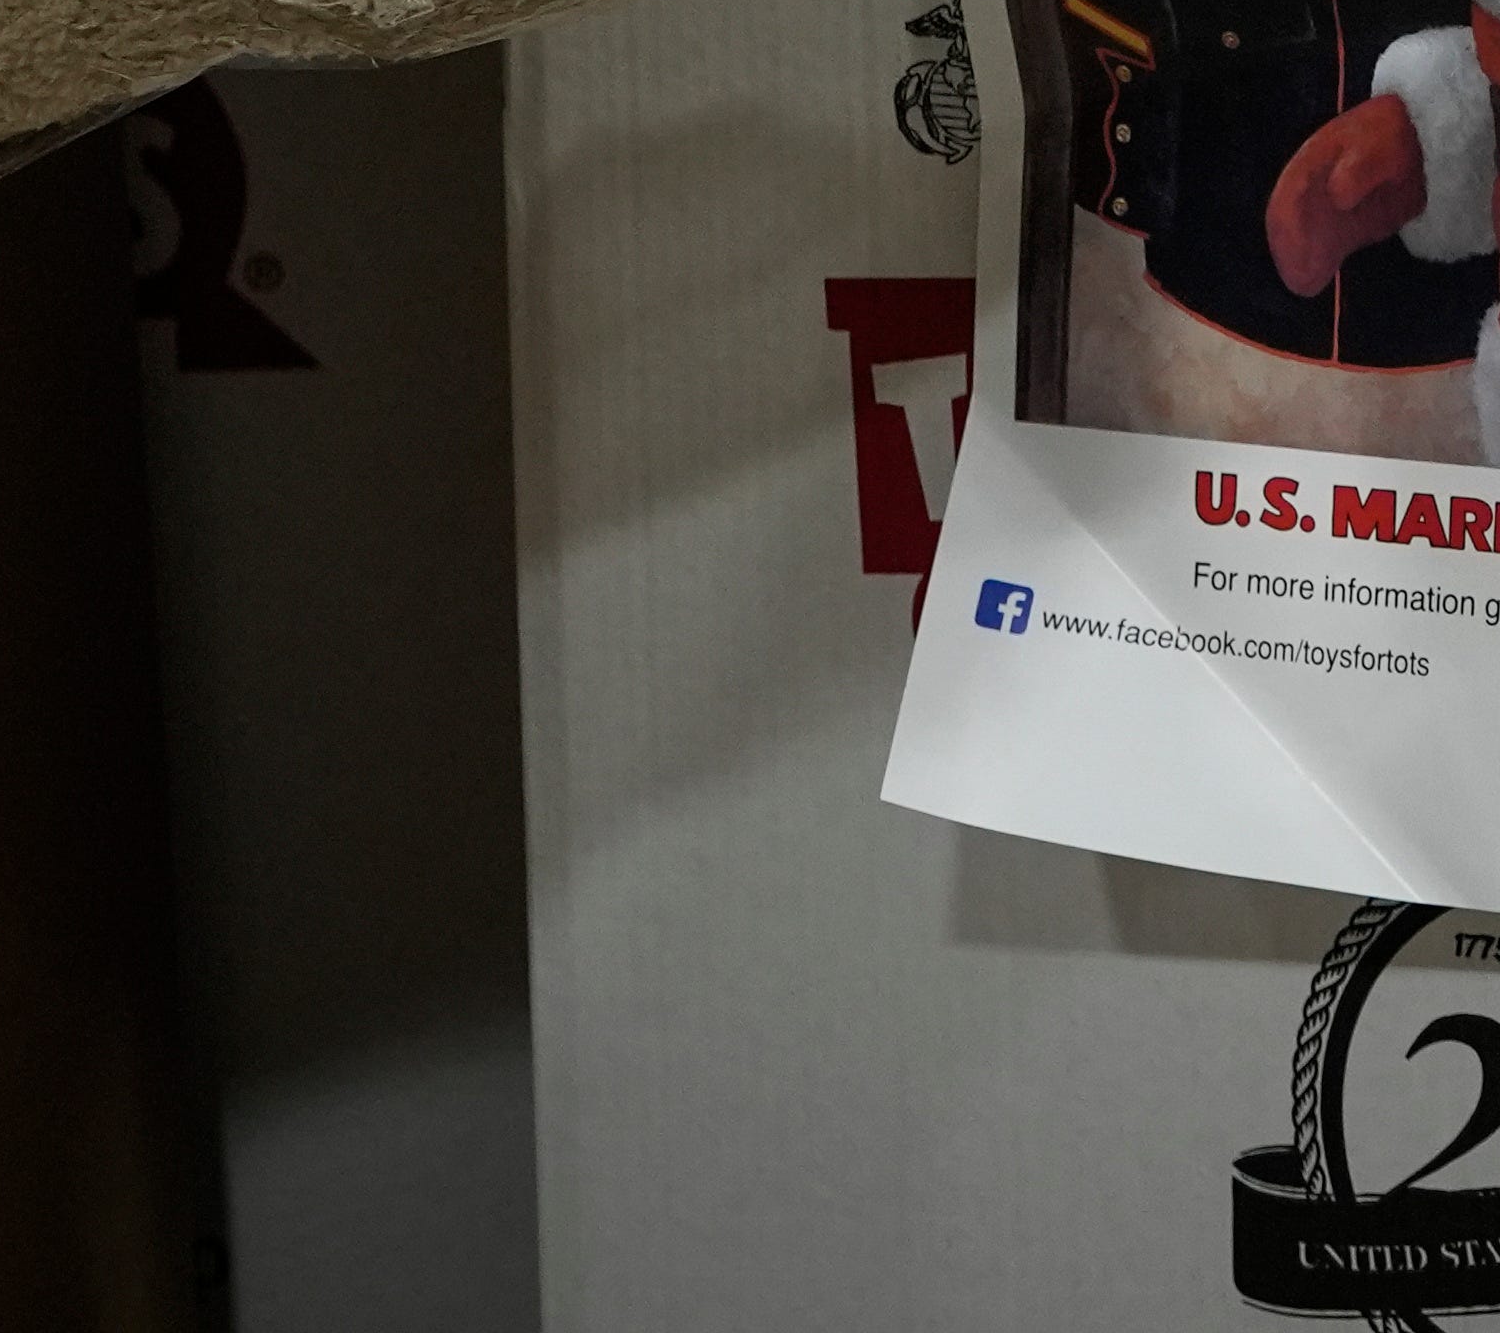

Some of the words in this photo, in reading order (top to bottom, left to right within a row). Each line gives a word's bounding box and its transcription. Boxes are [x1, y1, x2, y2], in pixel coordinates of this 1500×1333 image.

[1194, 470, 1316, 534] U.S.
[1192, 562, 1237, 594] For
[1245, 571, 1315, 602] more
[1323, 575, 1476, 619] information
[1042, 610, 1431, 678] www.facebook.com/toysfortots
[1299, 1239, 1428, 1275] UNITED
